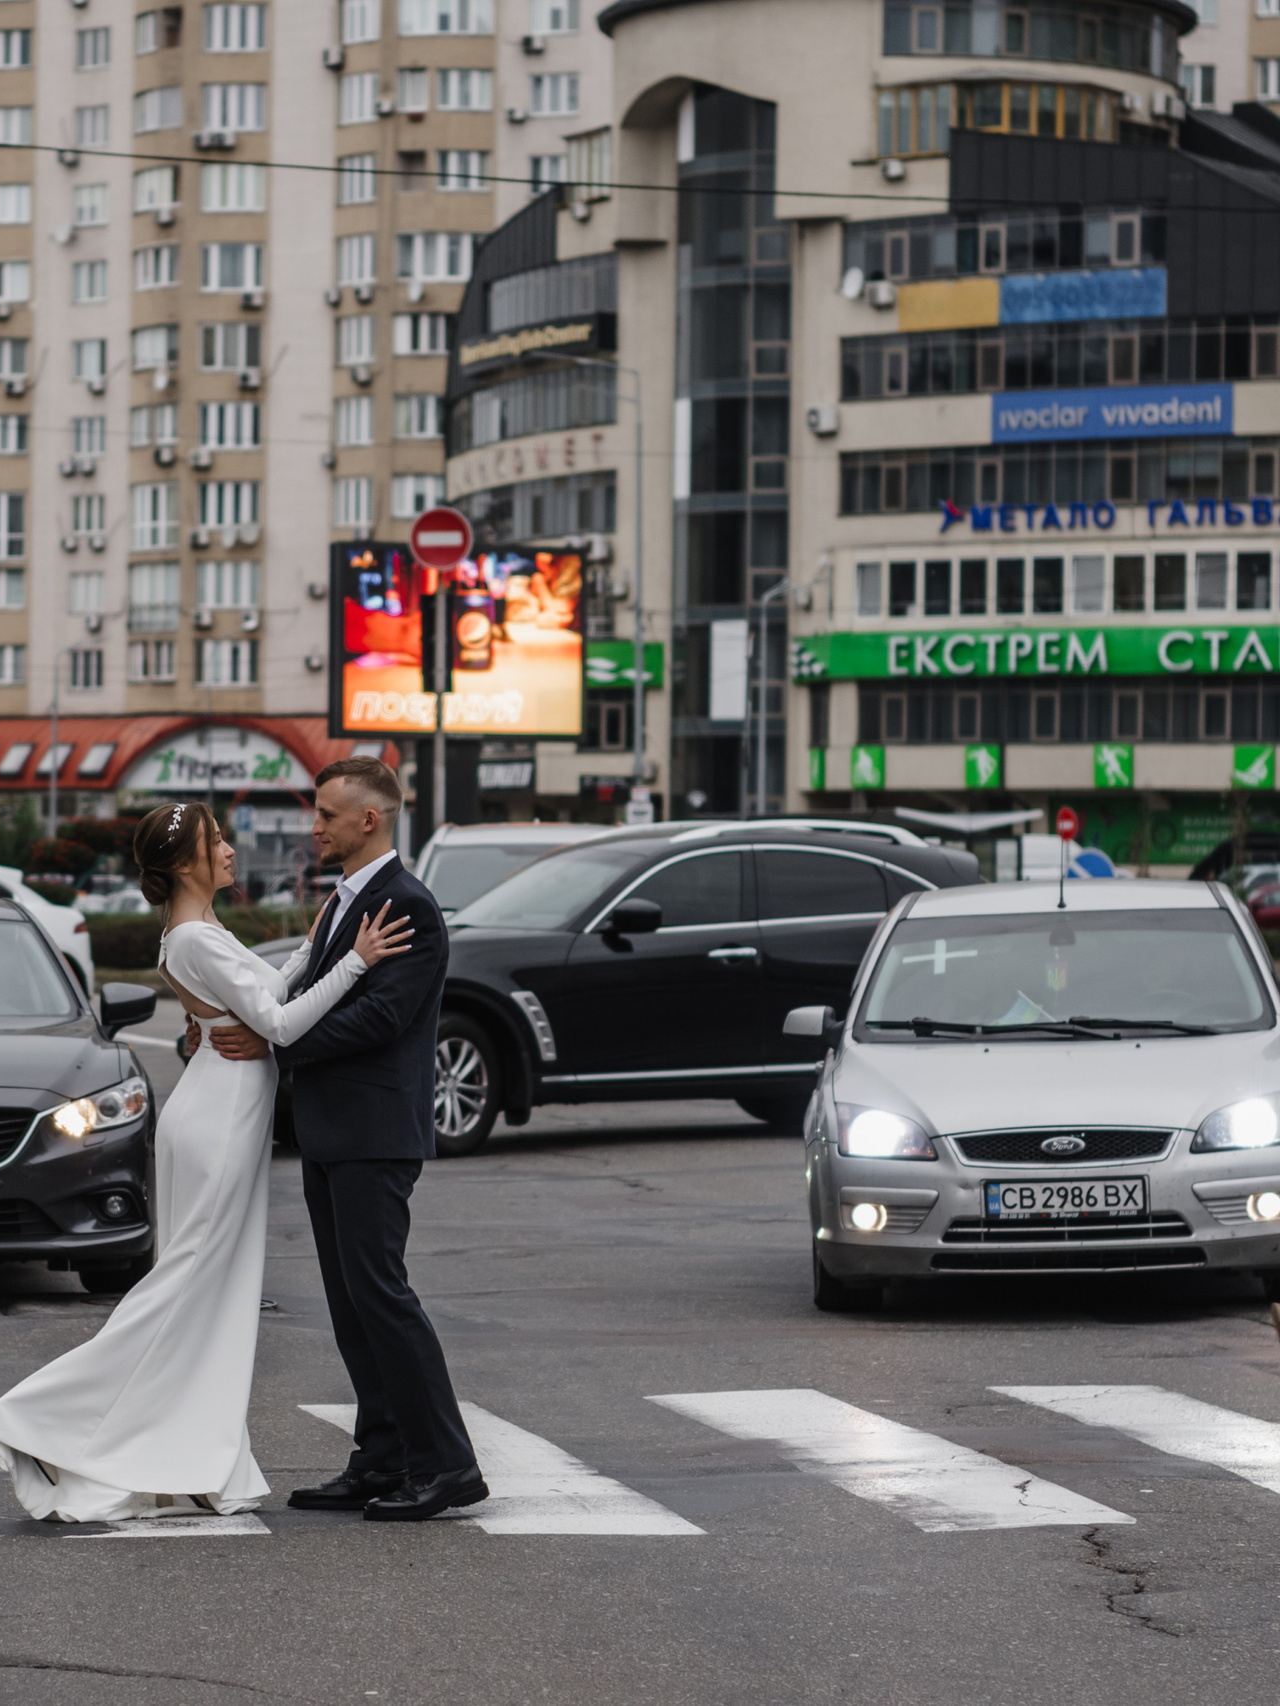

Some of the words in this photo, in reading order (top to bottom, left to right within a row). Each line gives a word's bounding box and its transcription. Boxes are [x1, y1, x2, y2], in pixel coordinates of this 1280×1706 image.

[1000, 404, 1088, 430] ivoclar
[1102, 396, 1223, 426] vivadent
[971, 501, 1116, 532] МЕТАЛО
[1148, 496, 1280, 529] ГАЛЬВ
[887, 633, 1108, 675] ЕКСТРЕМ
[1158, 629, 1280, 673] СТА
[1051, 1139, 1075, 1151] Ford
[989, 1203, 1000, 1211] UA
[1001, 1187, 1036, 1210] CB
[1042, 1186, 1098, 1209] 2986
[1104, 1184, 1139, 1207] BX
